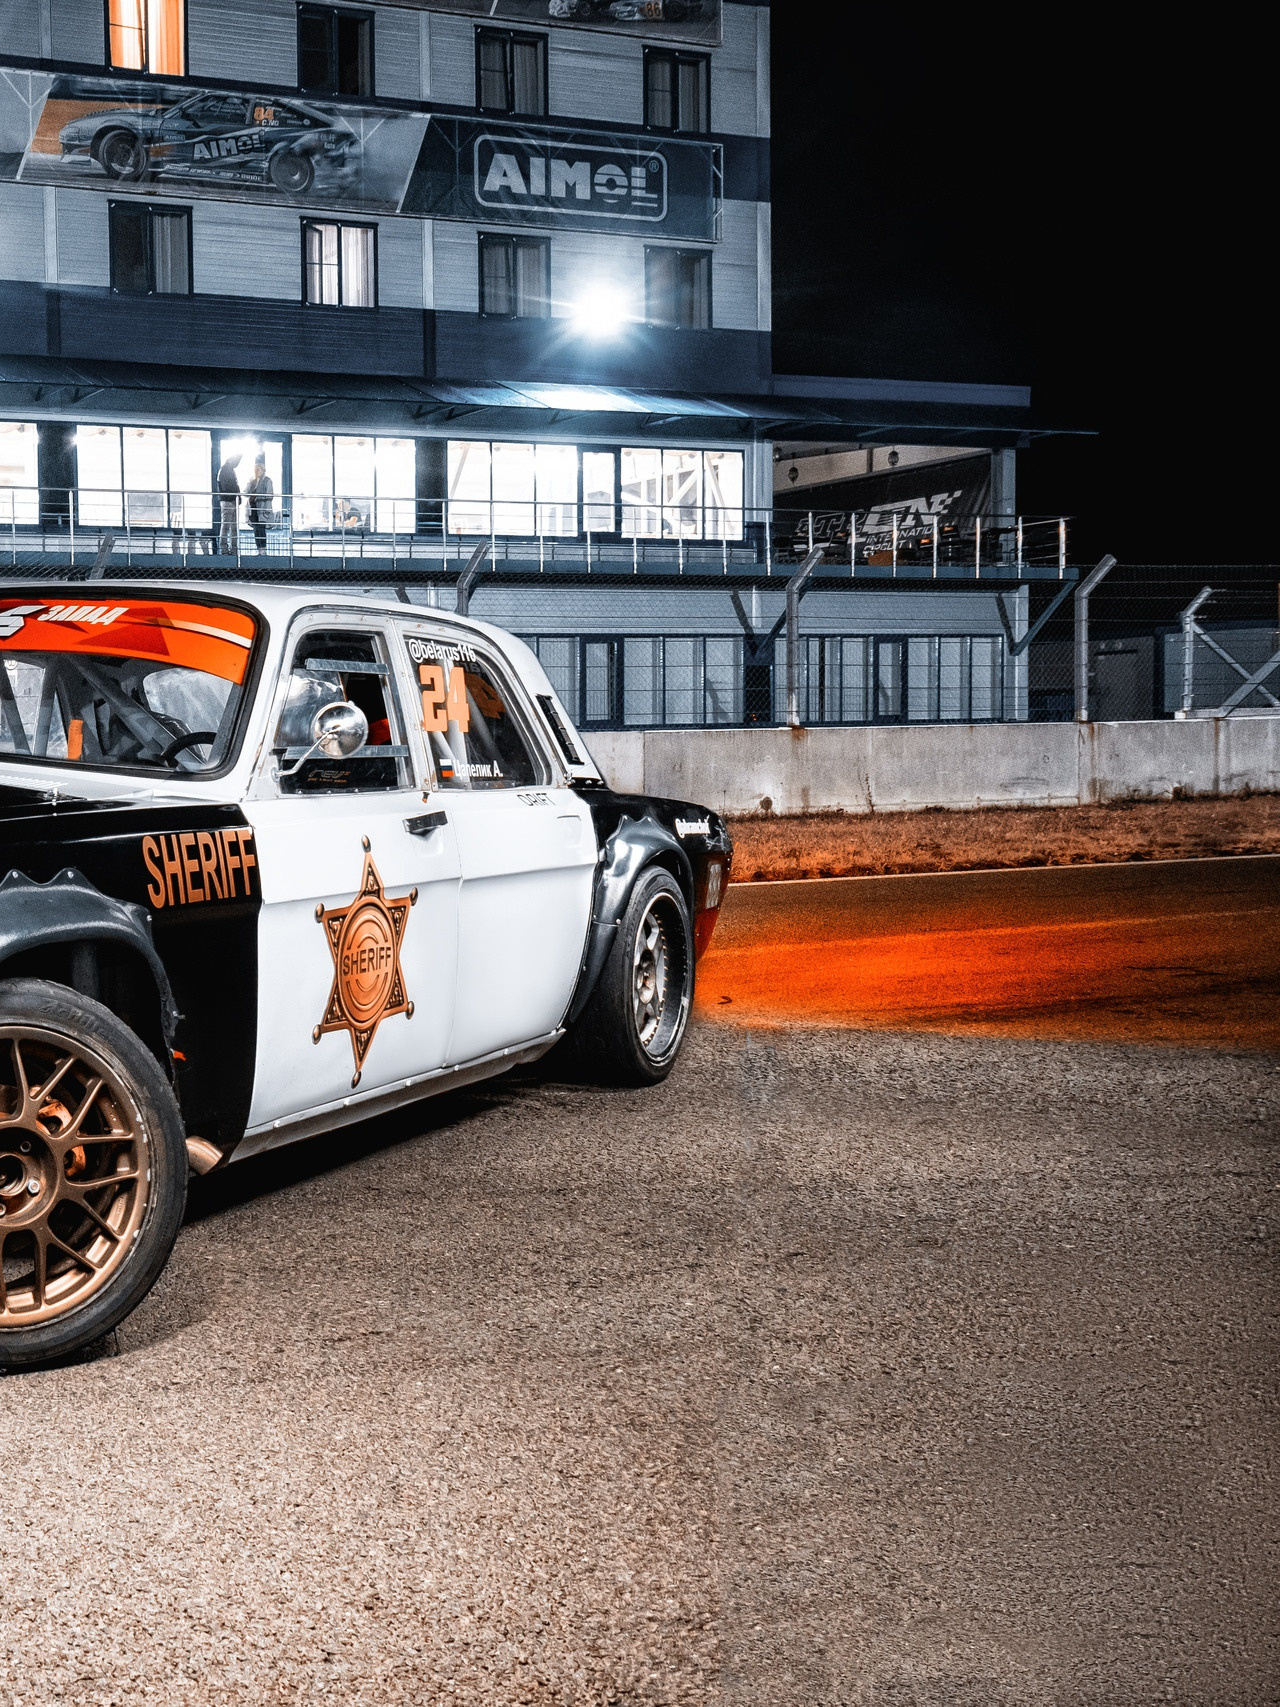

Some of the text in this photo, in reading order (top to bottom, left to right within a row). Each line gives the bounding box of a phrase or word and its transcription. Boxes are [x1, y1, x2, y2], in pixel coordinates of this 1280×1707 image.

[193, 133, 267, 160] AIMOL
[483, 153, 658, 207] AIMOL
[38, 605, 130, 626] ЗАПАД
[409, 638, 476, 663] @belarus116
[419, 664, 470, 733] 24
[517, 793, 556, 806] DRIFT
[142, 829, 255, 909] SHERIFF
[343, 947, 391, 976] SHERIFF
